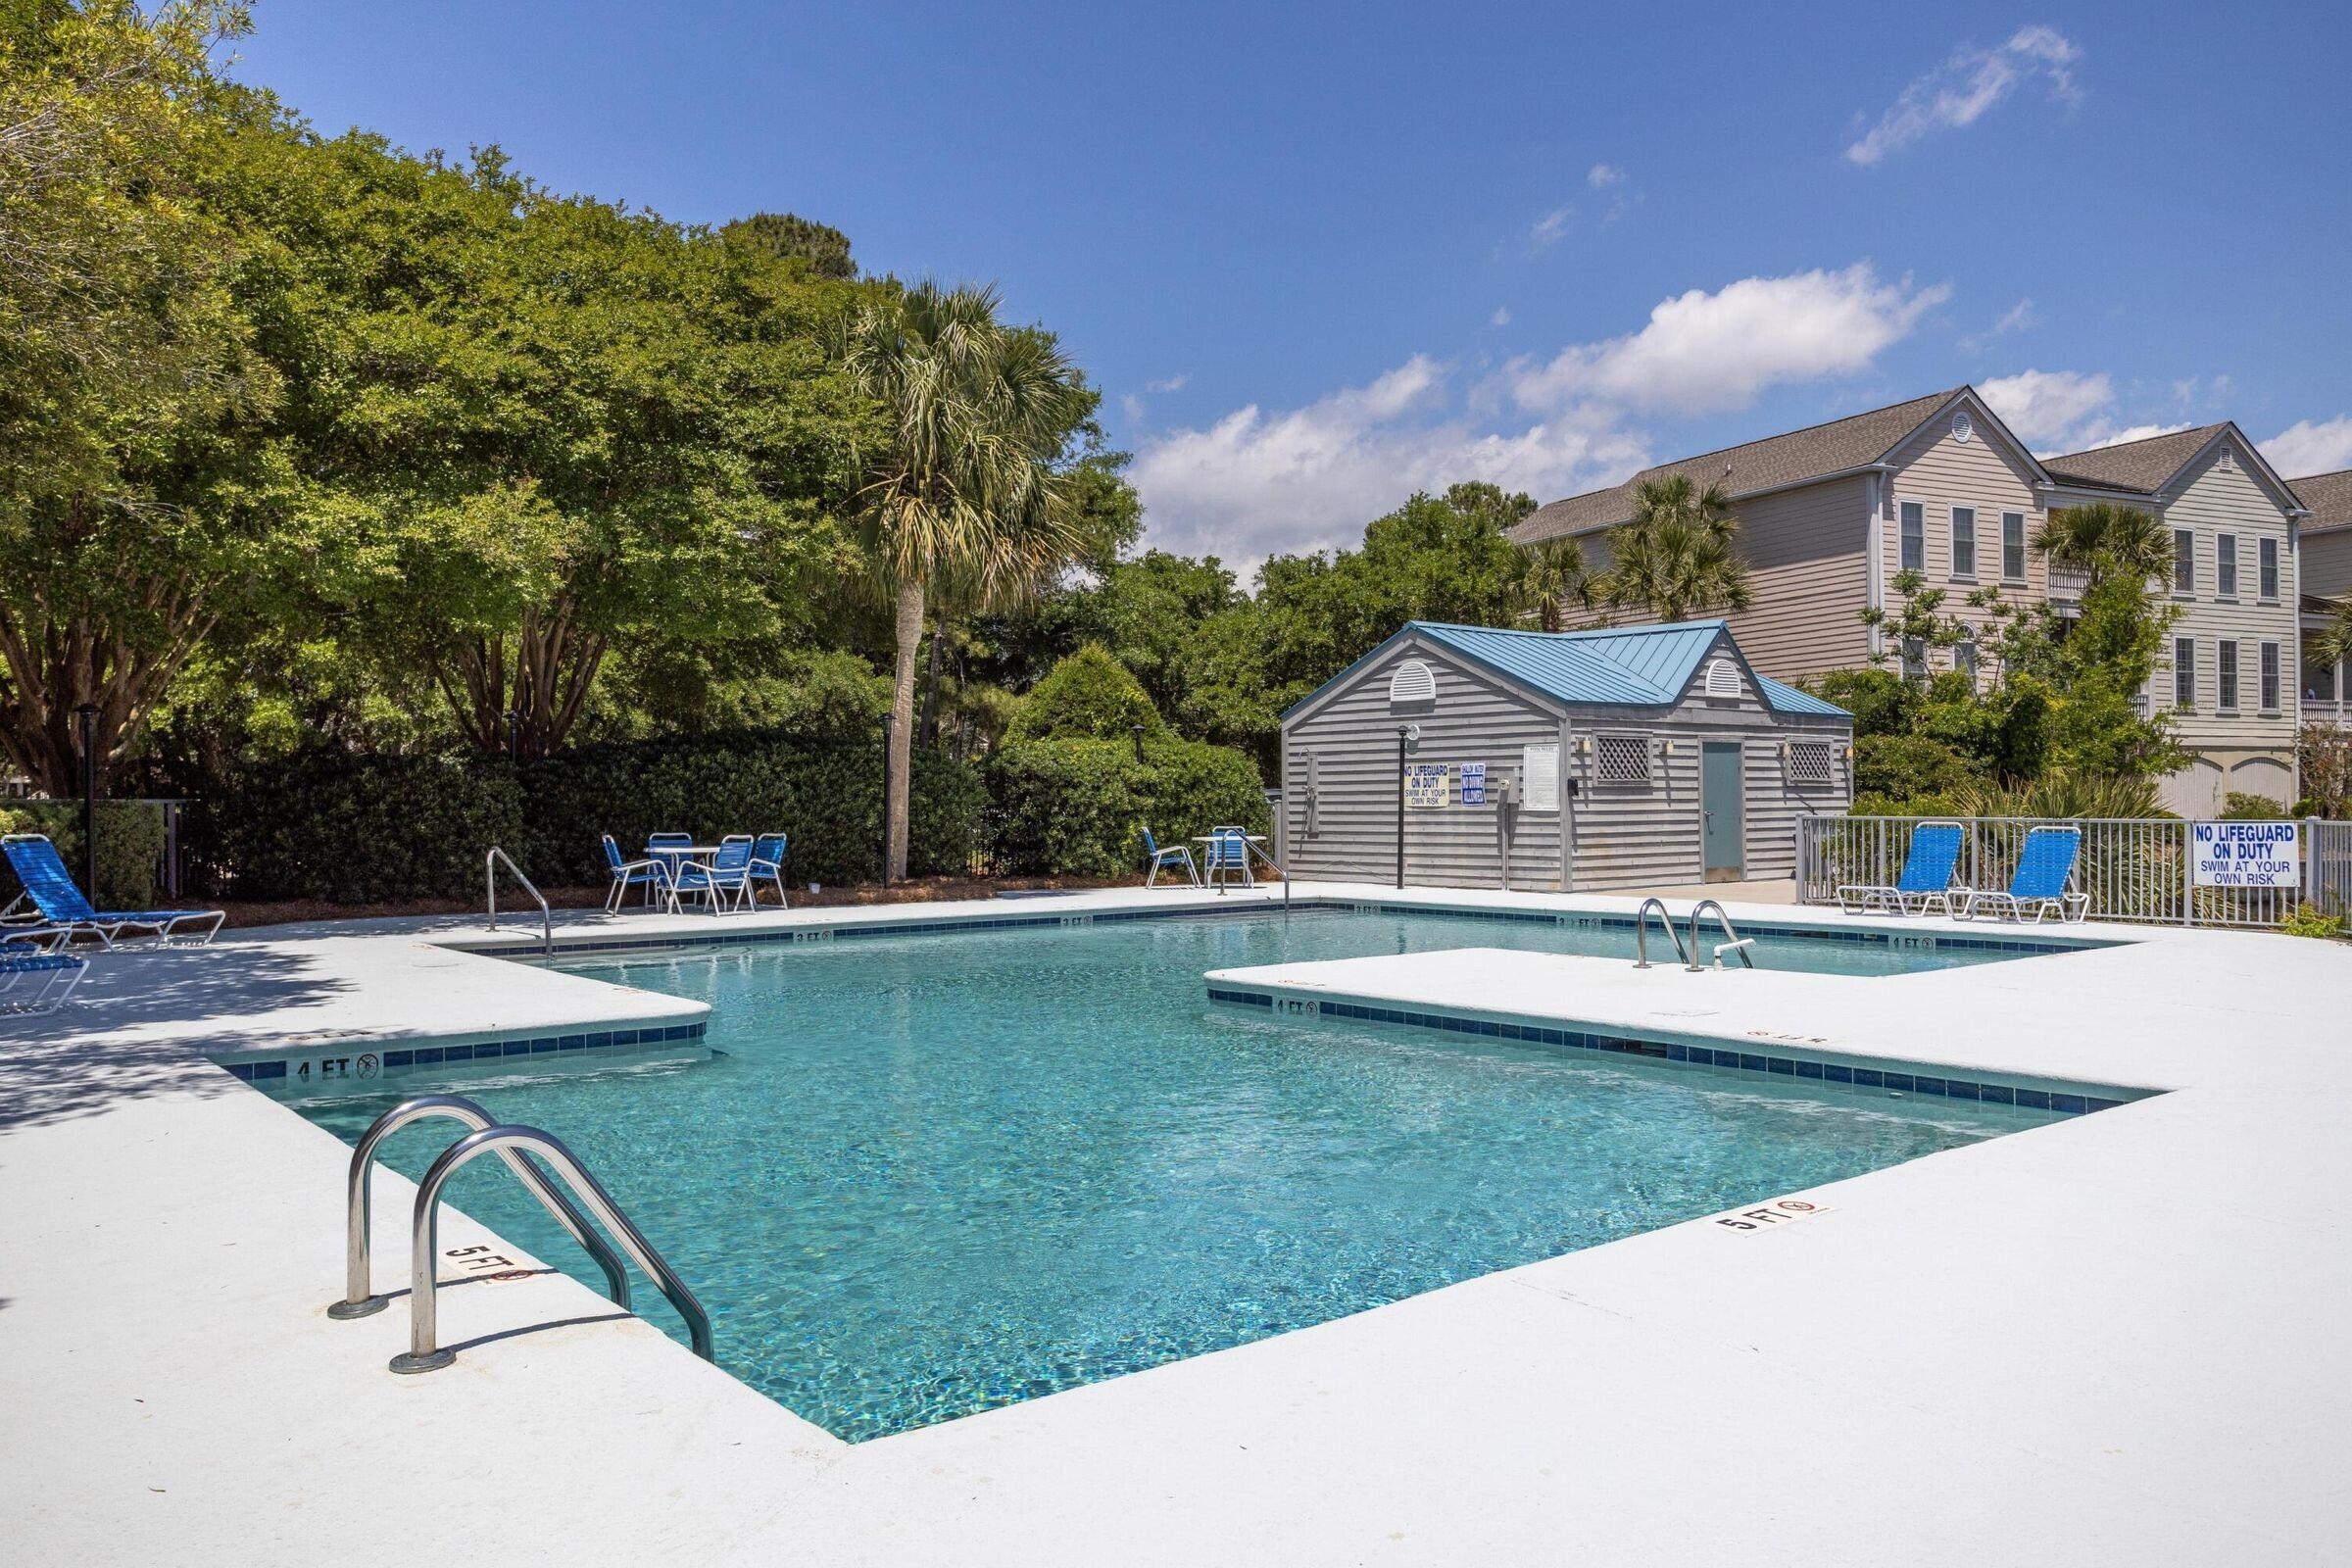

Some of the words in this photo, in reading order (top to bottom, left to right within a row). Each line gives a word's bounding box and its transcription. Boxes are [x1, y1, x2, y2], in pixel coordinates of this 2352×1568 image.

[1404, 765, 1412, 777] NO
[1414, 765, 1448, 777] LIFEGUARD
[1411, 777, 1420, 789] ON
[1423, 777, 1439, 789] DUTY
[1404, 789, 1420, 798] SWIM
[1430, 788, 1446, 797] YOUR
[2196, 825, 2213, 842] NO
[2219, 824, 2294, 842] LIFEGUARD
[2213, 843, 2230, 859] ON
[2238, 843, 2274, 859] DUTY
[2201, 860, 2230, 872] SWIM
[2234, 860, 2249, 872] AT
[2255, 860, 2290, 873] YOUR
[2215, 872, 2241, 885] OWN
[2247, 873, 2275, 885] RISK
[1904, 937, 1919, 948] FT
[321, 1058, 350, 1074] FT
[1715, 1218, 1758, 1231] 5
[1741, 1208, 1793, 1224] FT
[445, 1245, 491, 1257] 5
[458, 1255, 515, 1271] FT
